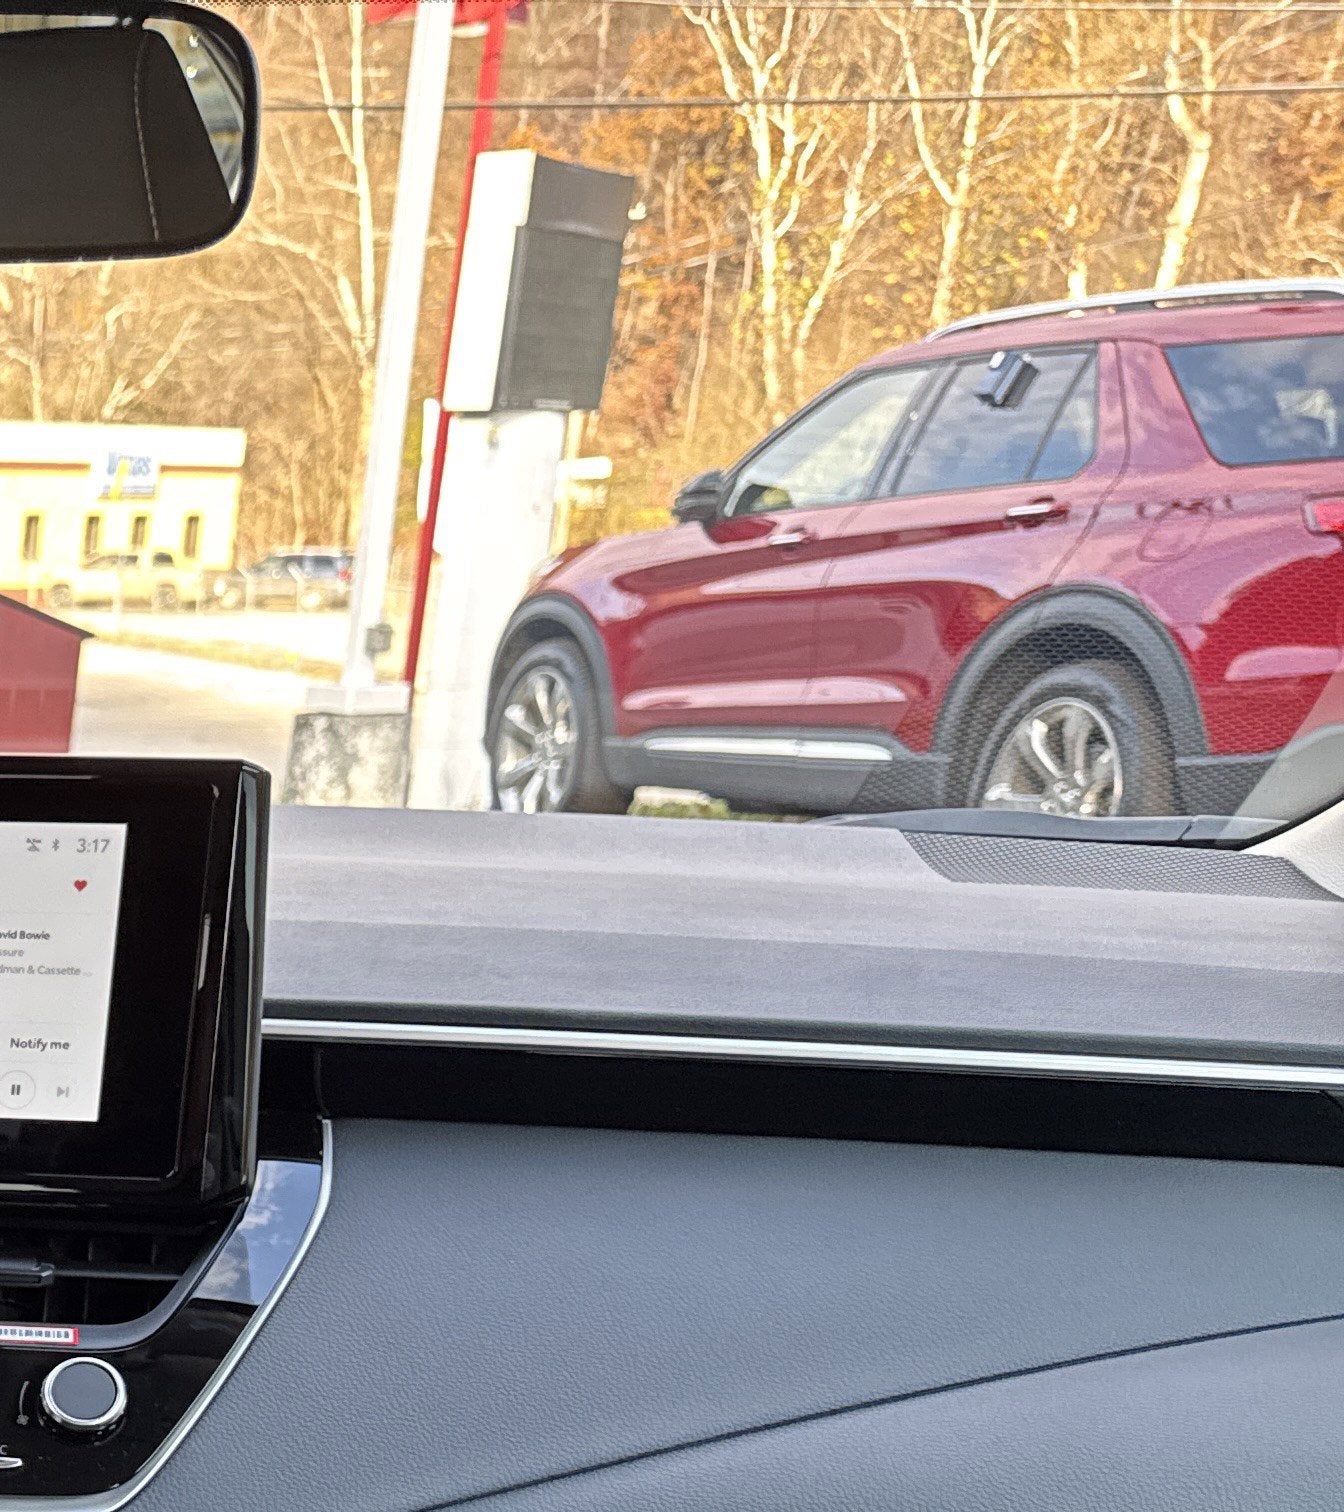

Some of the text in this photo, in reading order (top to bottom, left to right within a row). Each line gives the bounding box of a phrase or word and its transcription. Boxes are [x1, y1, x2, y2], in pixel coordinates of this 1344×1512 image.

[76, 838, 111, 853] 3:17
[19, 930, 51, 940] Bowie
[27, 965, 35, 974] &
[38, 965, 81, 976] Cassette
[10, 1037, 70, 1052] Notify me
